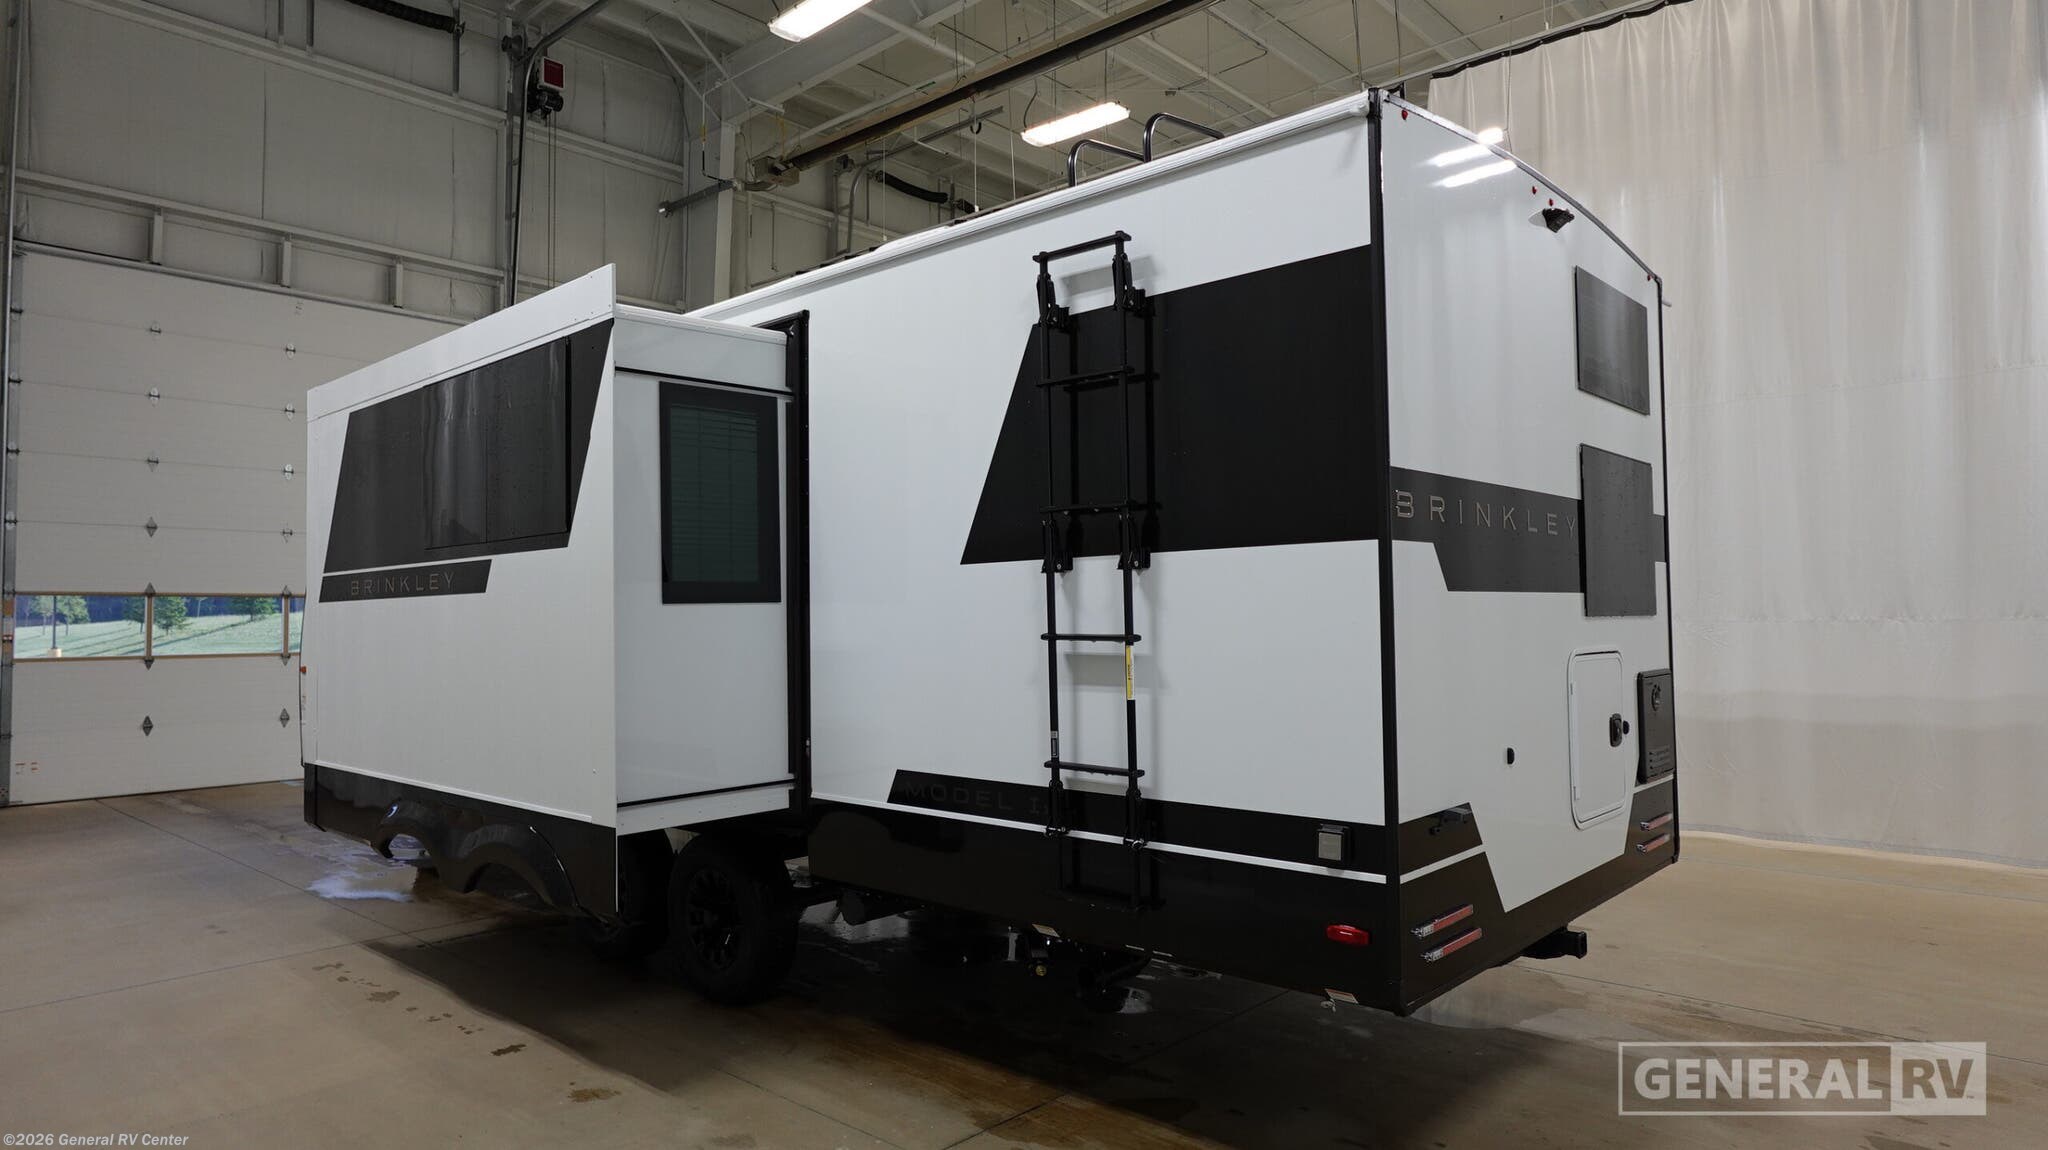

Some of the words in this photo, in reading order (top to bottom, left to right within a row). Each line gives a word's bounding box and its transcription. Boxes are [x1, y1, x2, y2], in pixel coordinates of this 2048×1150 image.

[1395, 489, 1576, 537] BRINKLEY
[351, 572, 454, 596] BRINKLEY
[905, 782, 1014, 811] MODEL
